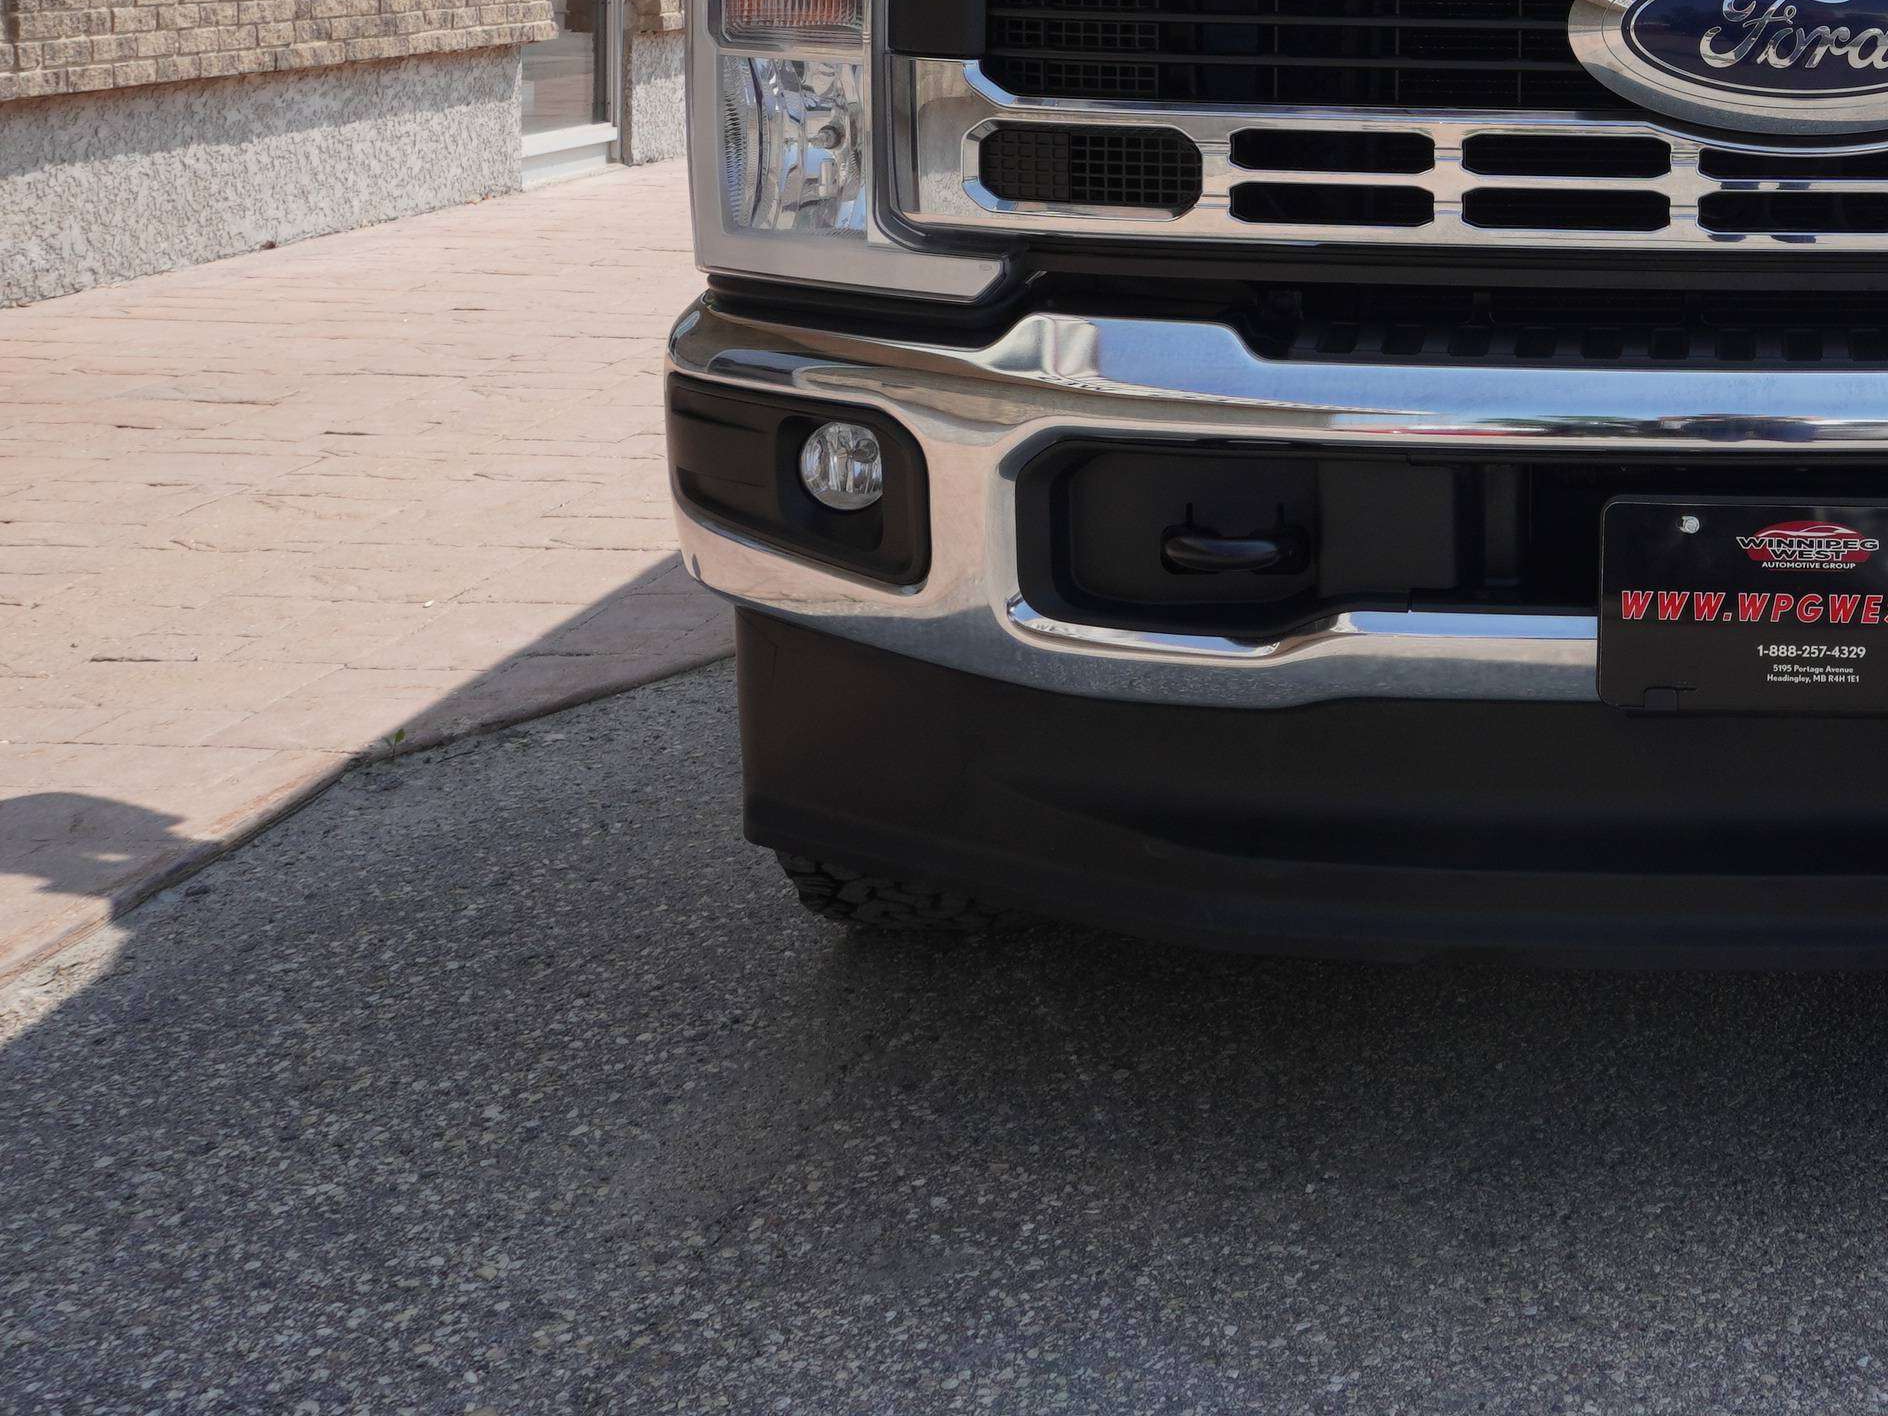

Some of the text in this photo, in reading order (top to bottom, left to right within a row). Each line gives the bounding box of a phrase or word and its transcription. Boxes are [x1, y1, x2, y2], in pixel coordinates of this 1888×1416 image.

[1735, 536, 1880, 551] WINNIPEG
[1768, 548, 1848, 562] WEST
[1761, 561, 1856, 570] AUTOMOTIVE GROUP
[1757, 645, 1867, 658] 1-888-257-4329
[1773, 664, 1854, 674] 5195 Portage Avenue
[1813, 674, 1827, 682] MB
